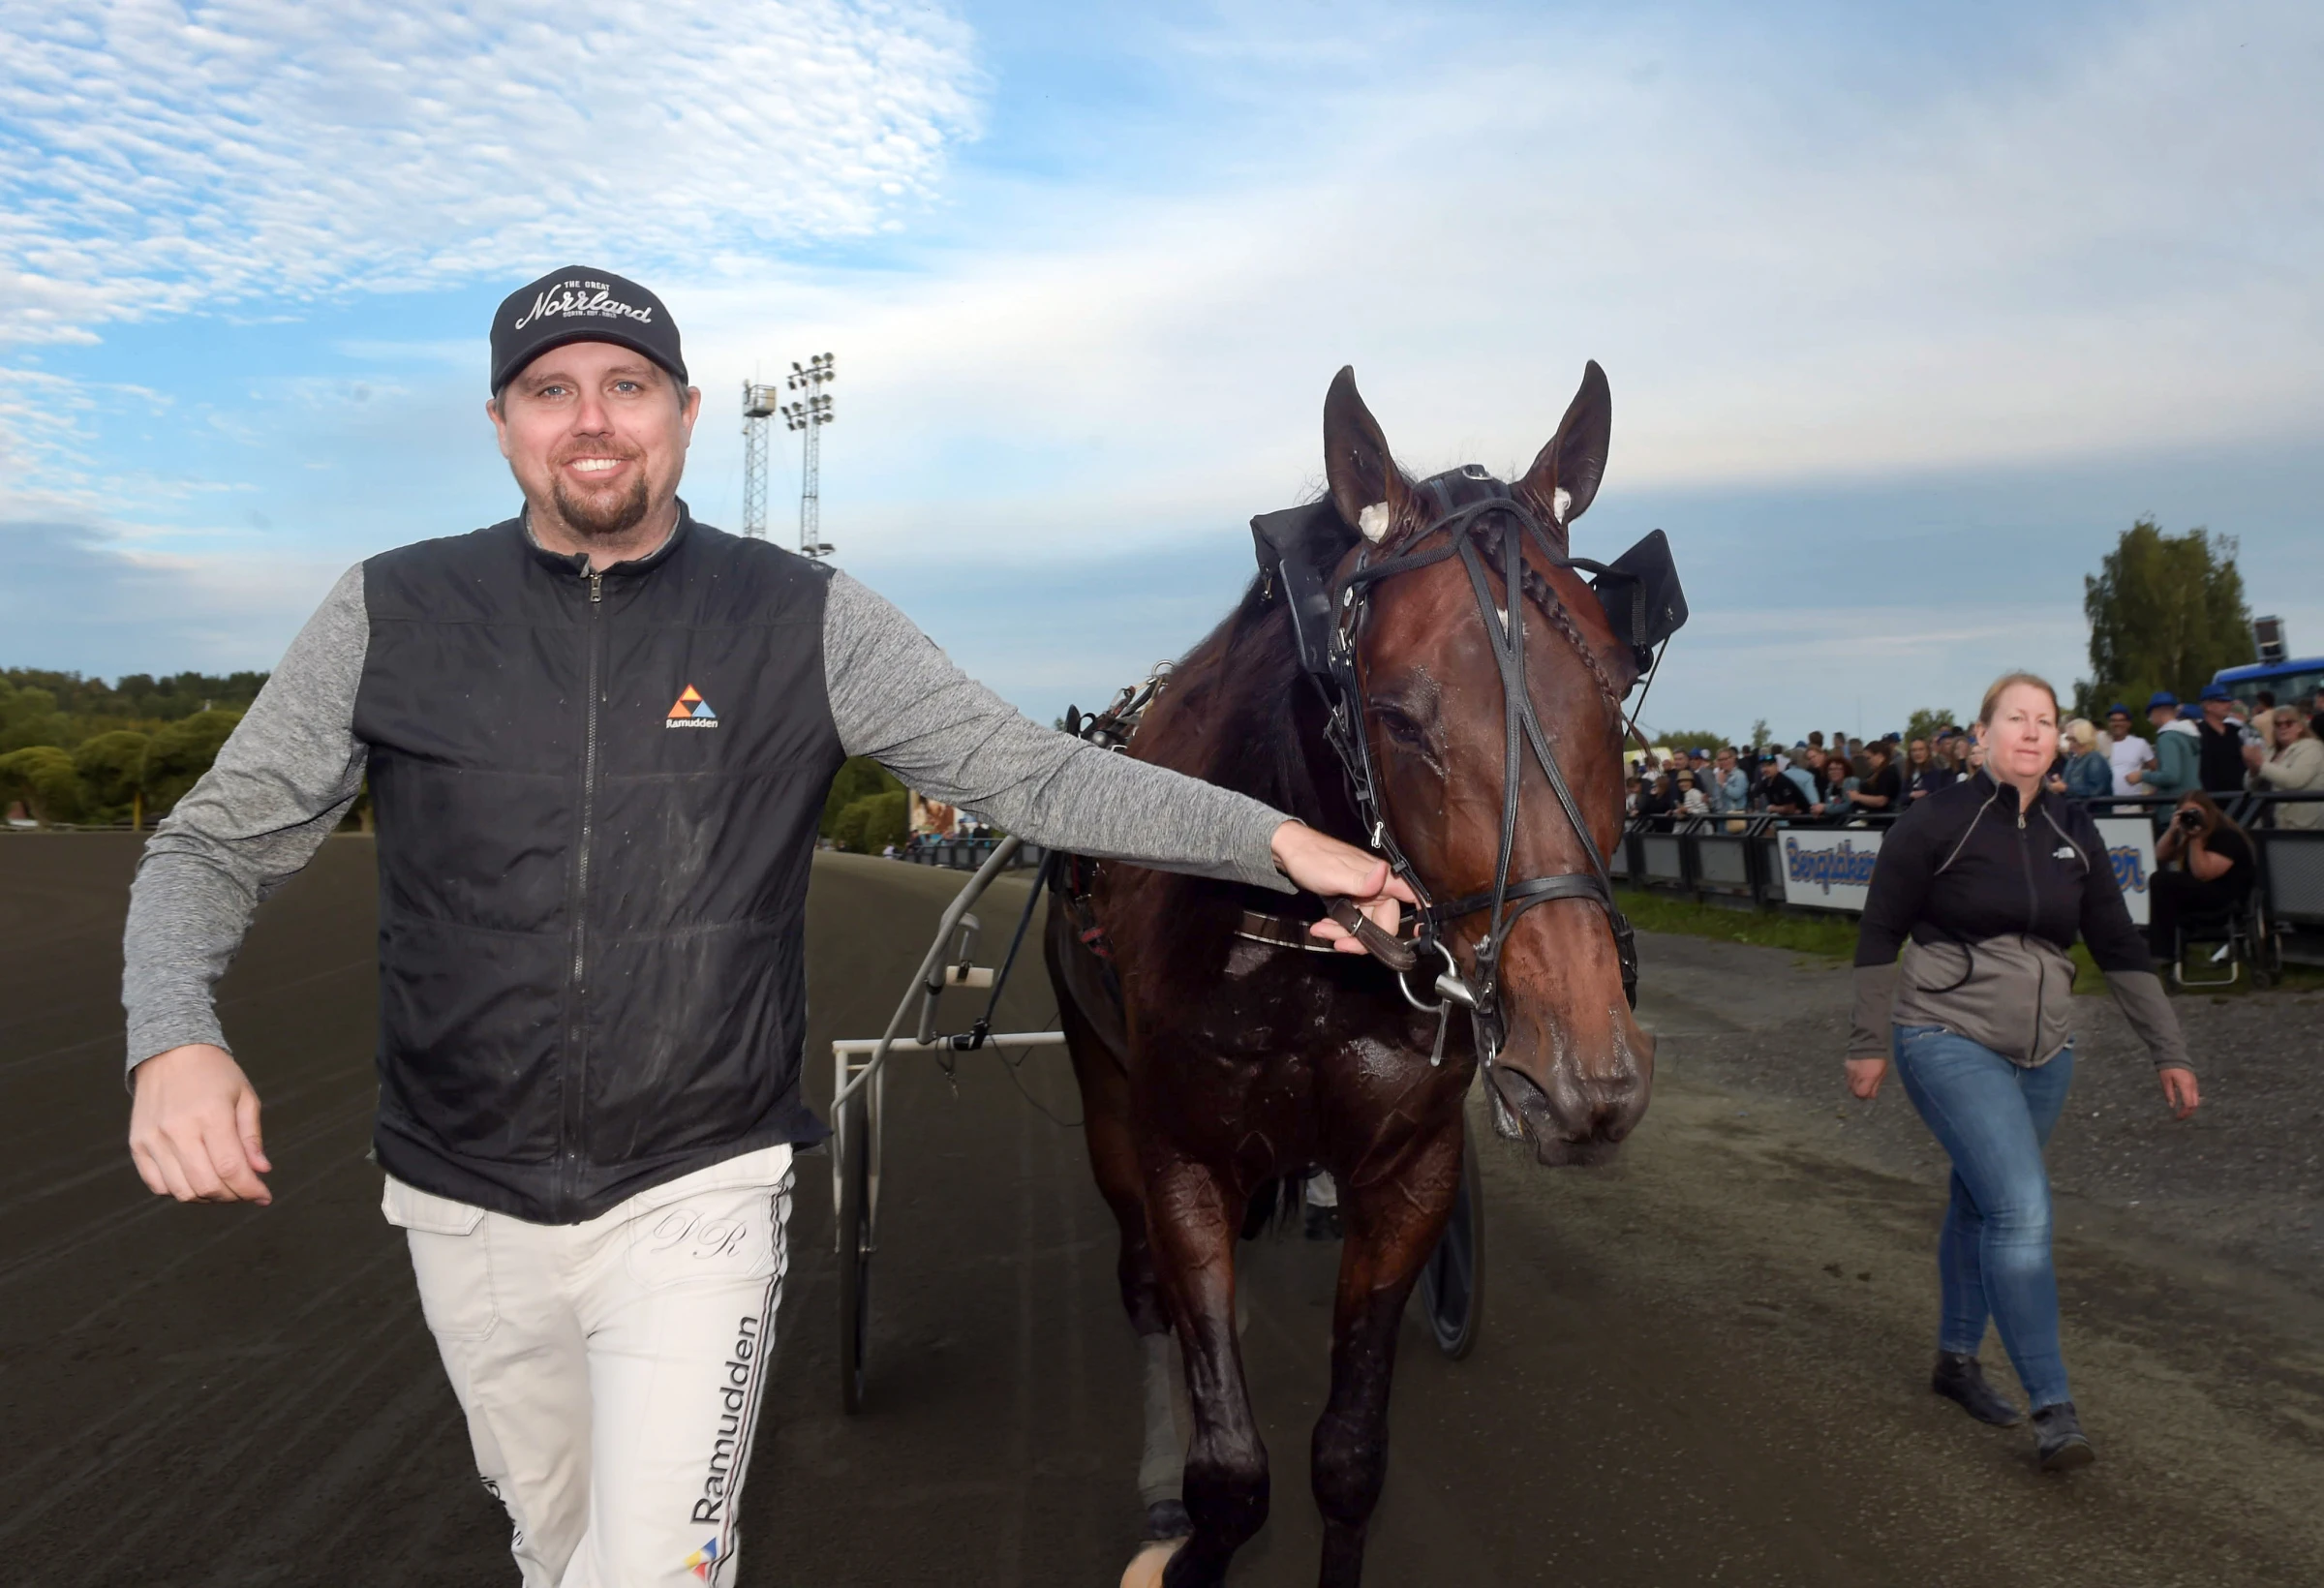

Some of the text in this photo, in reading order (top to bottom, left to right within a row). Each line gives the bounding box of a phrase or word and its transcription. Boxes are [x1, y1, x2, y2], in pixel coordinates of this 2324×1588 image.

[564, 280, 610, 291] THE GREAT
[515, 283, 652, 329] Norrland
[665, 718, 719, 729] Ramudden
[689, 1316, 758, 1525] Ramudden
